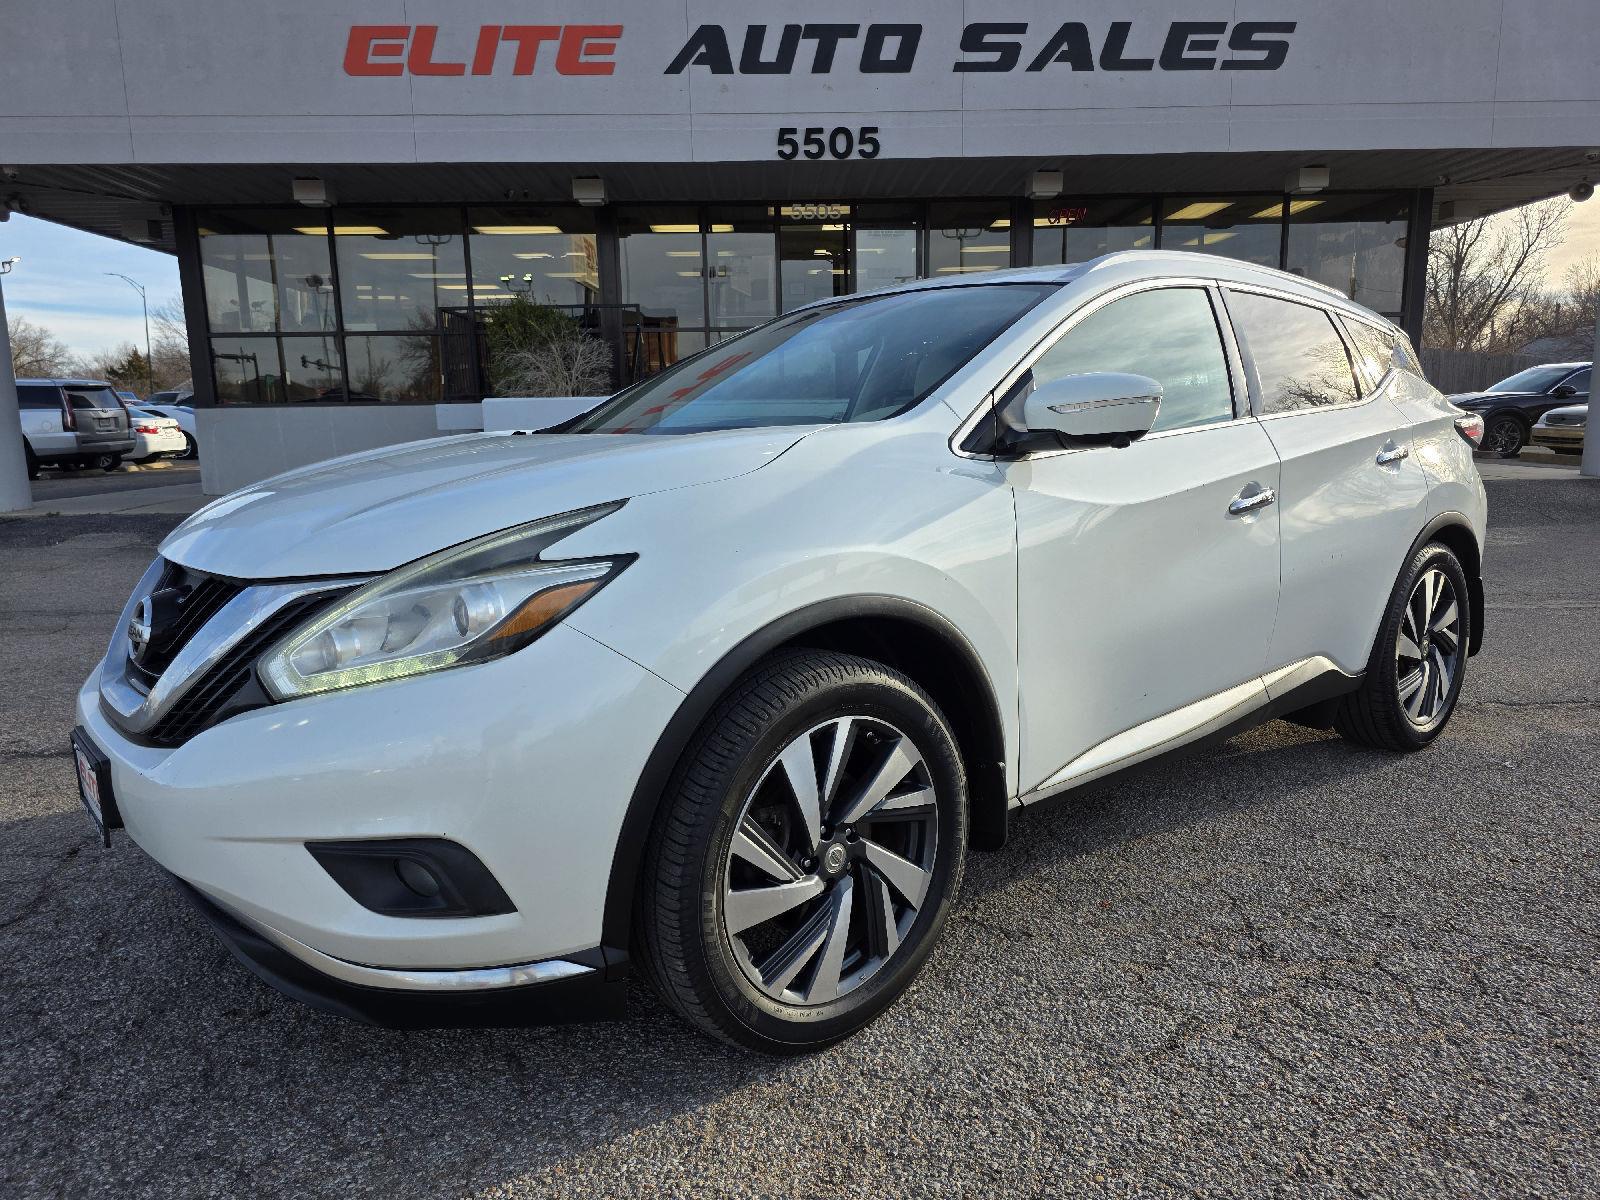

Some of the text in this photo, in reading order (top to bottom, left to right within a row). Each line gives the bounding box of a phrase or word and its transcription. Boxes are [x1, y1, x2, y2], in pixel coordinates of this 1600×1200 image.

[343, 21, 1298, 76] ELITE AUTO SALES
[776, 126, 881, 160] 5505
[790, 203, 842, 220] 5505
[1047, 206, 1088, 225] OPEN
